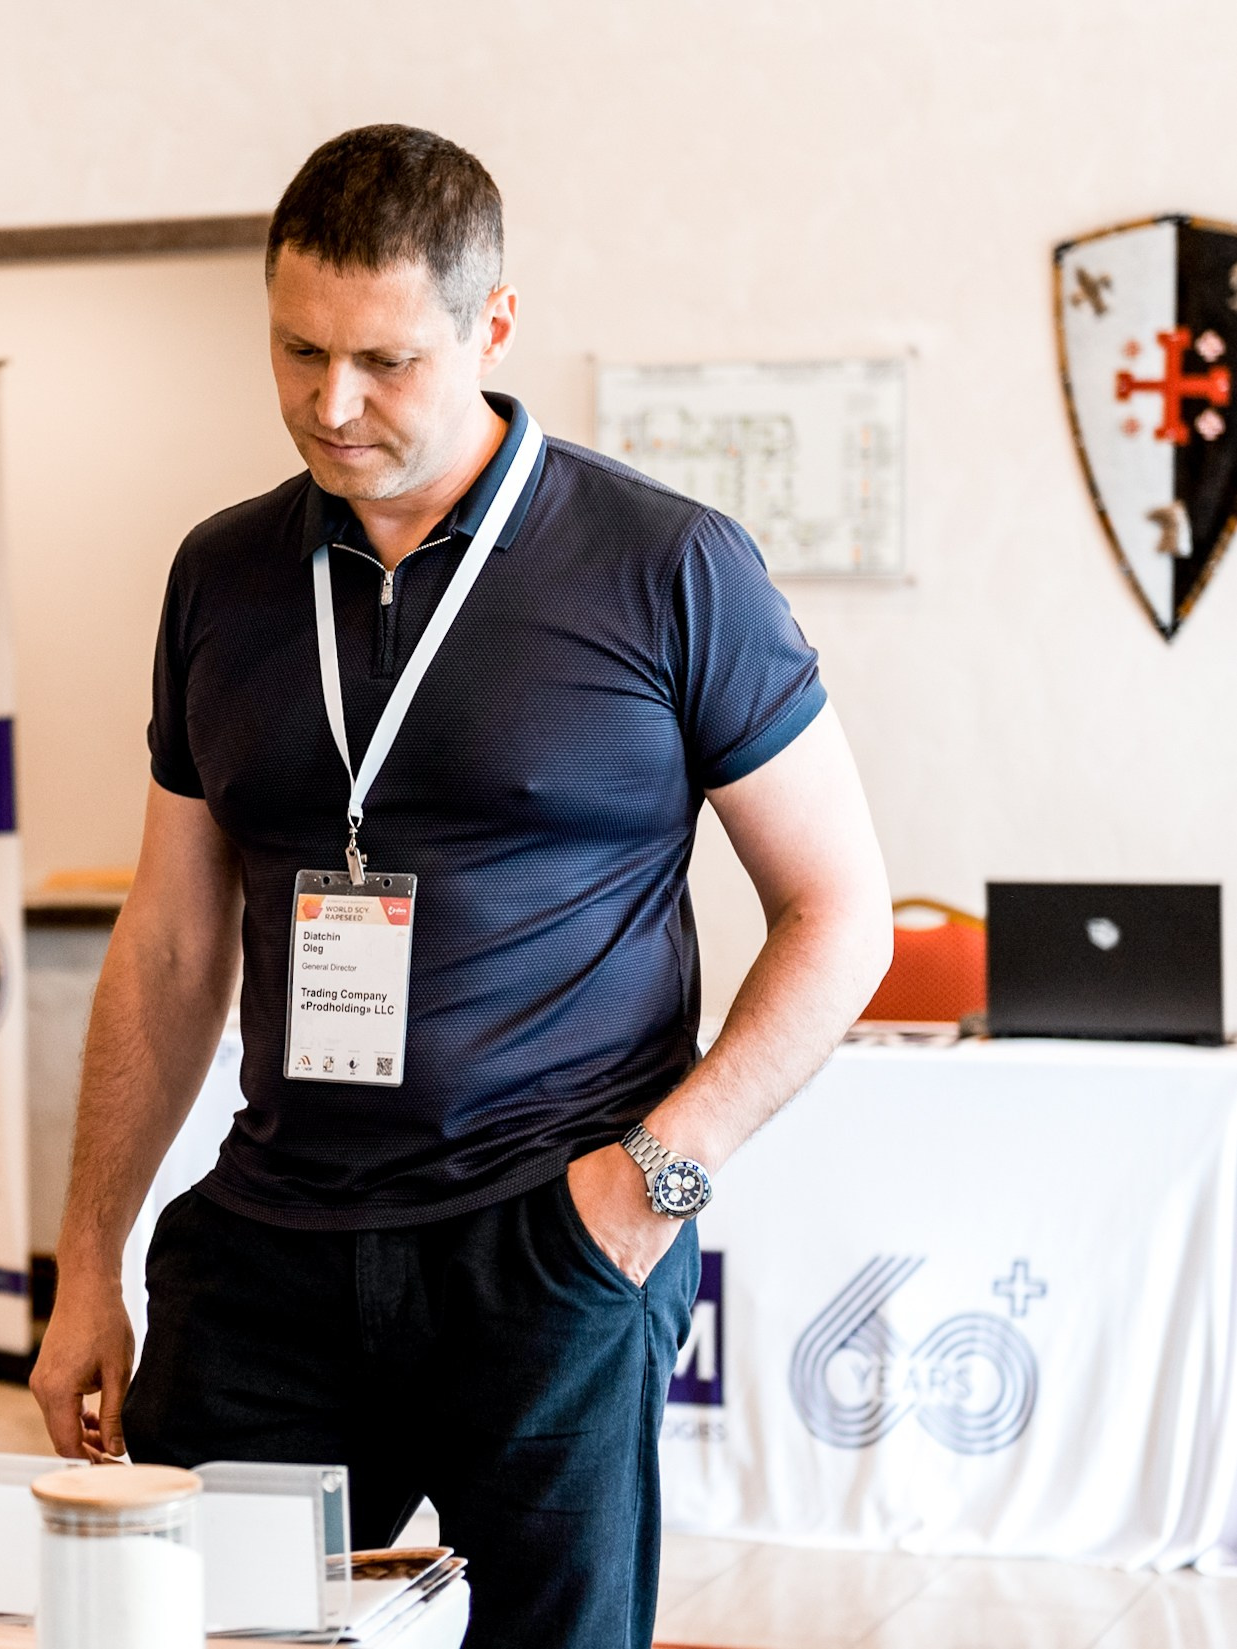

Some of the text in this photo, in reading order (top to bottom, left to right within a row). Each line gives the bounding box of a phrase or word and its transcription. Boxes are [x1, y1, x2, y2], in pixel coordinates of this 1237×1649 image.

[325, 913, 363, 922] RAPESEED
[303, 931, 341, 941] Diatchin
[303, 943, 324, 955] Oleg
[302, 962, 357, 972] General Director
[301, 987, 387, 1003] Trading Company
[301, 1001, 395, 1016] «Prodholding» LLC
